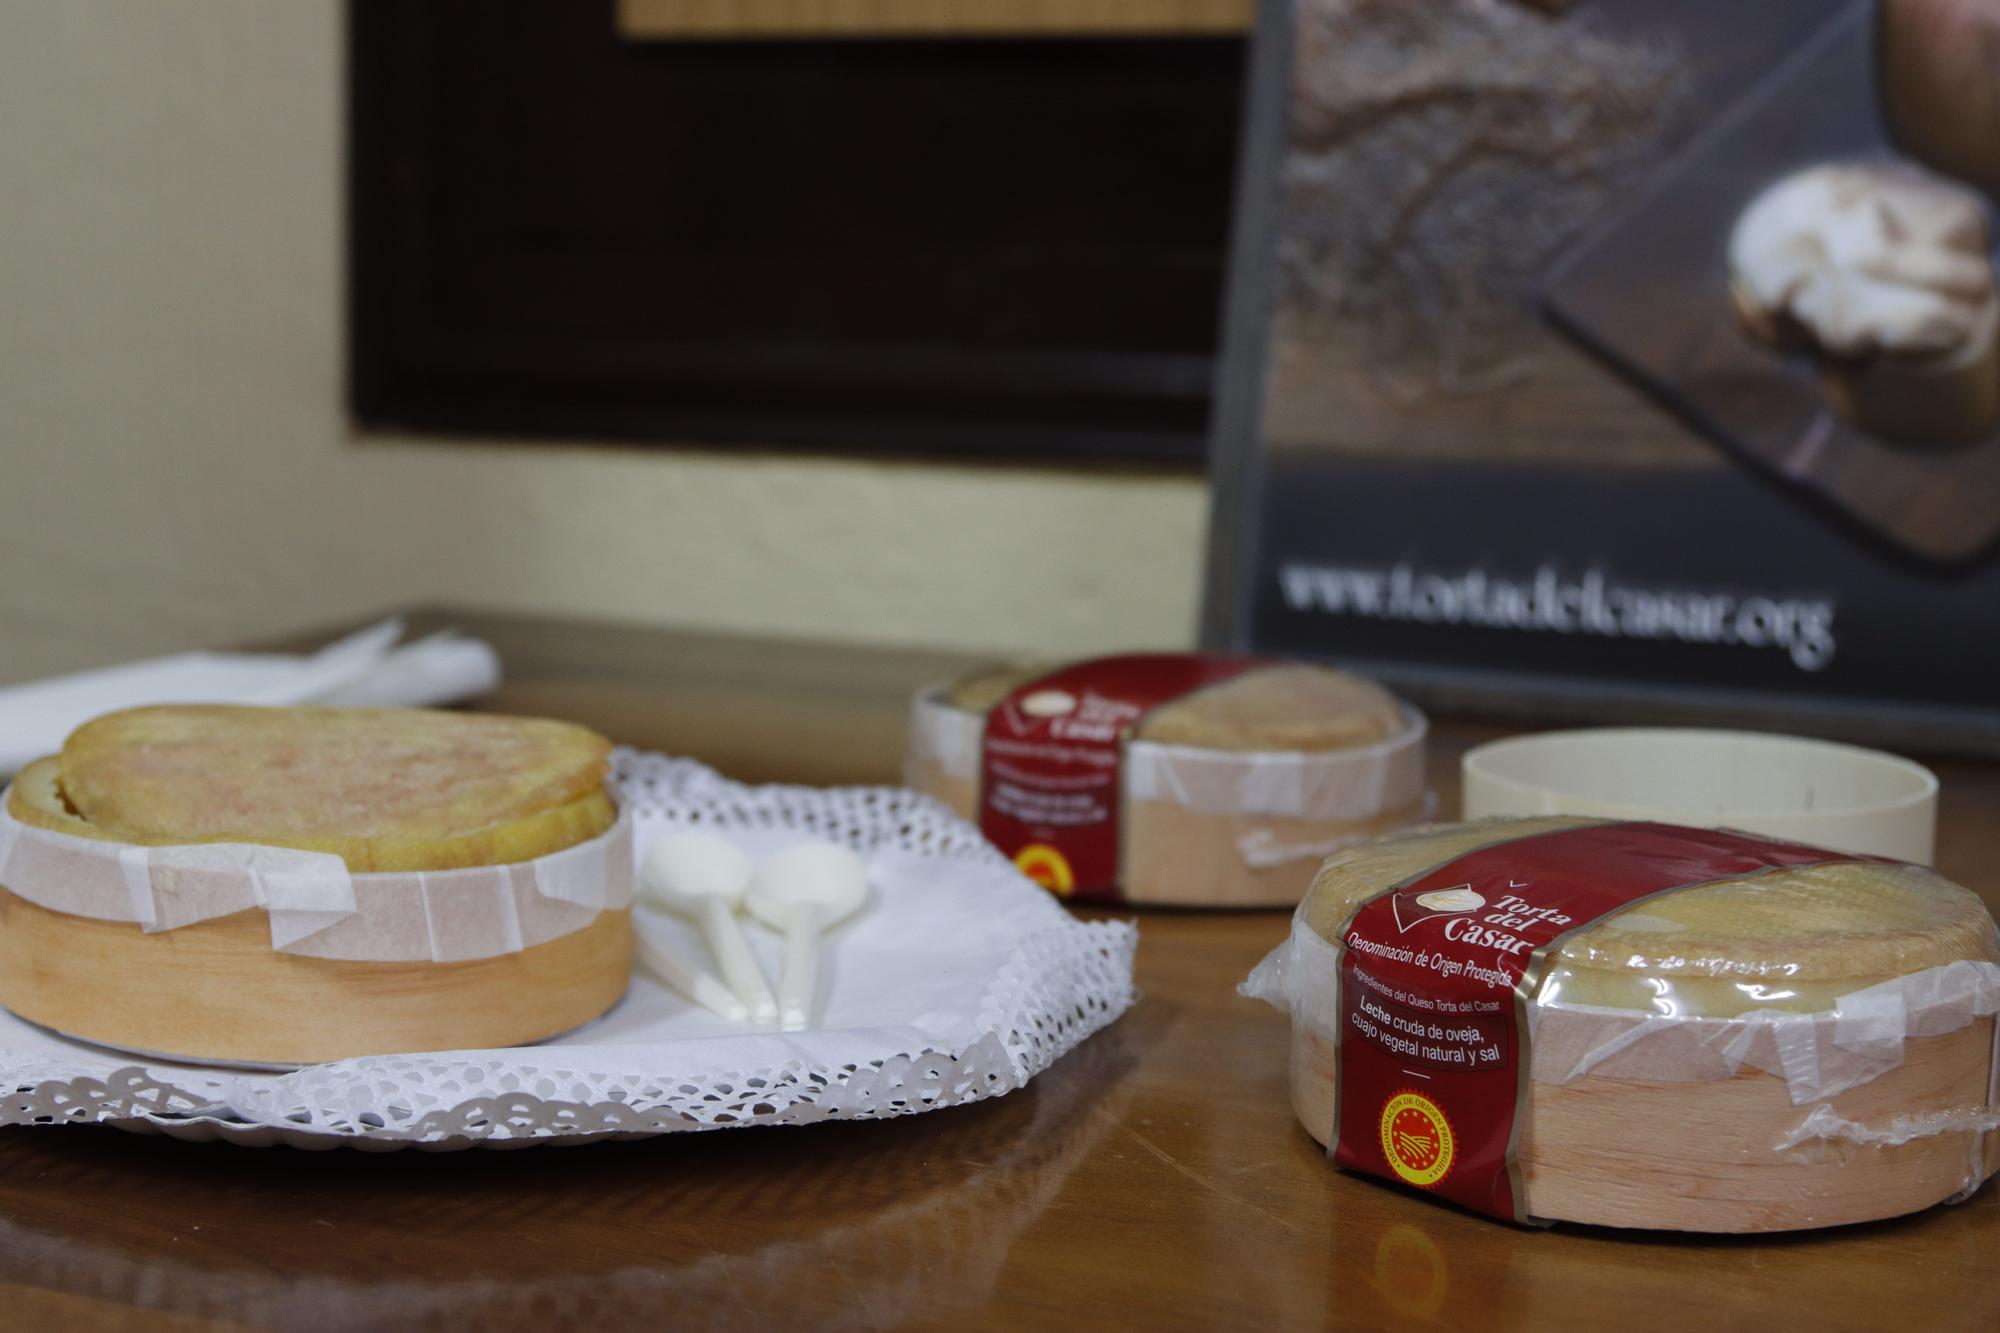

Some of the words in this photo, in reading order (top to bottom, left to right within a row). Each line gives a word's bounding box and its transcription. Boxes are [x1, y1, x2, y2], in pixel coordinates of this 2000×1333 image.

[1484, 912, 1539, 932] del
[1491, 895, 1571, 925] Torta
[1348, 931, 1412, 963] Denominación
[1415, 949, 1427, 967] de
[1430, 952, 1462, 977] Origen
[1444, 917, 1535, 955] Casar
[1353, 963, 1393, 998] Ingredientes
[1394, 990, 1406, 1002] del
[1407, 993, 1434, 1010] Queso
[1436, 999, 1457, 1013] Torta
[1459, 1000, 1473, 1013] del
[1473, 1000, 1500, 1012] Casar
[1352, 1012, 1377, 1038] cuajo
[1379, 1028, 1419, 1057] vegetal
[1421, 1044, 1465, 1063] natural
[1468, 1049, 1476, 1067] y
[1480, 1043, 1500, 1062] sal
[1360, 994, 1391, 1025] Leche
[1393, 1016, 1425, 1037] cruda
[1427, 1023, 1443, 1040] de
[1446, 1025, 1485, 1045] oveja,
